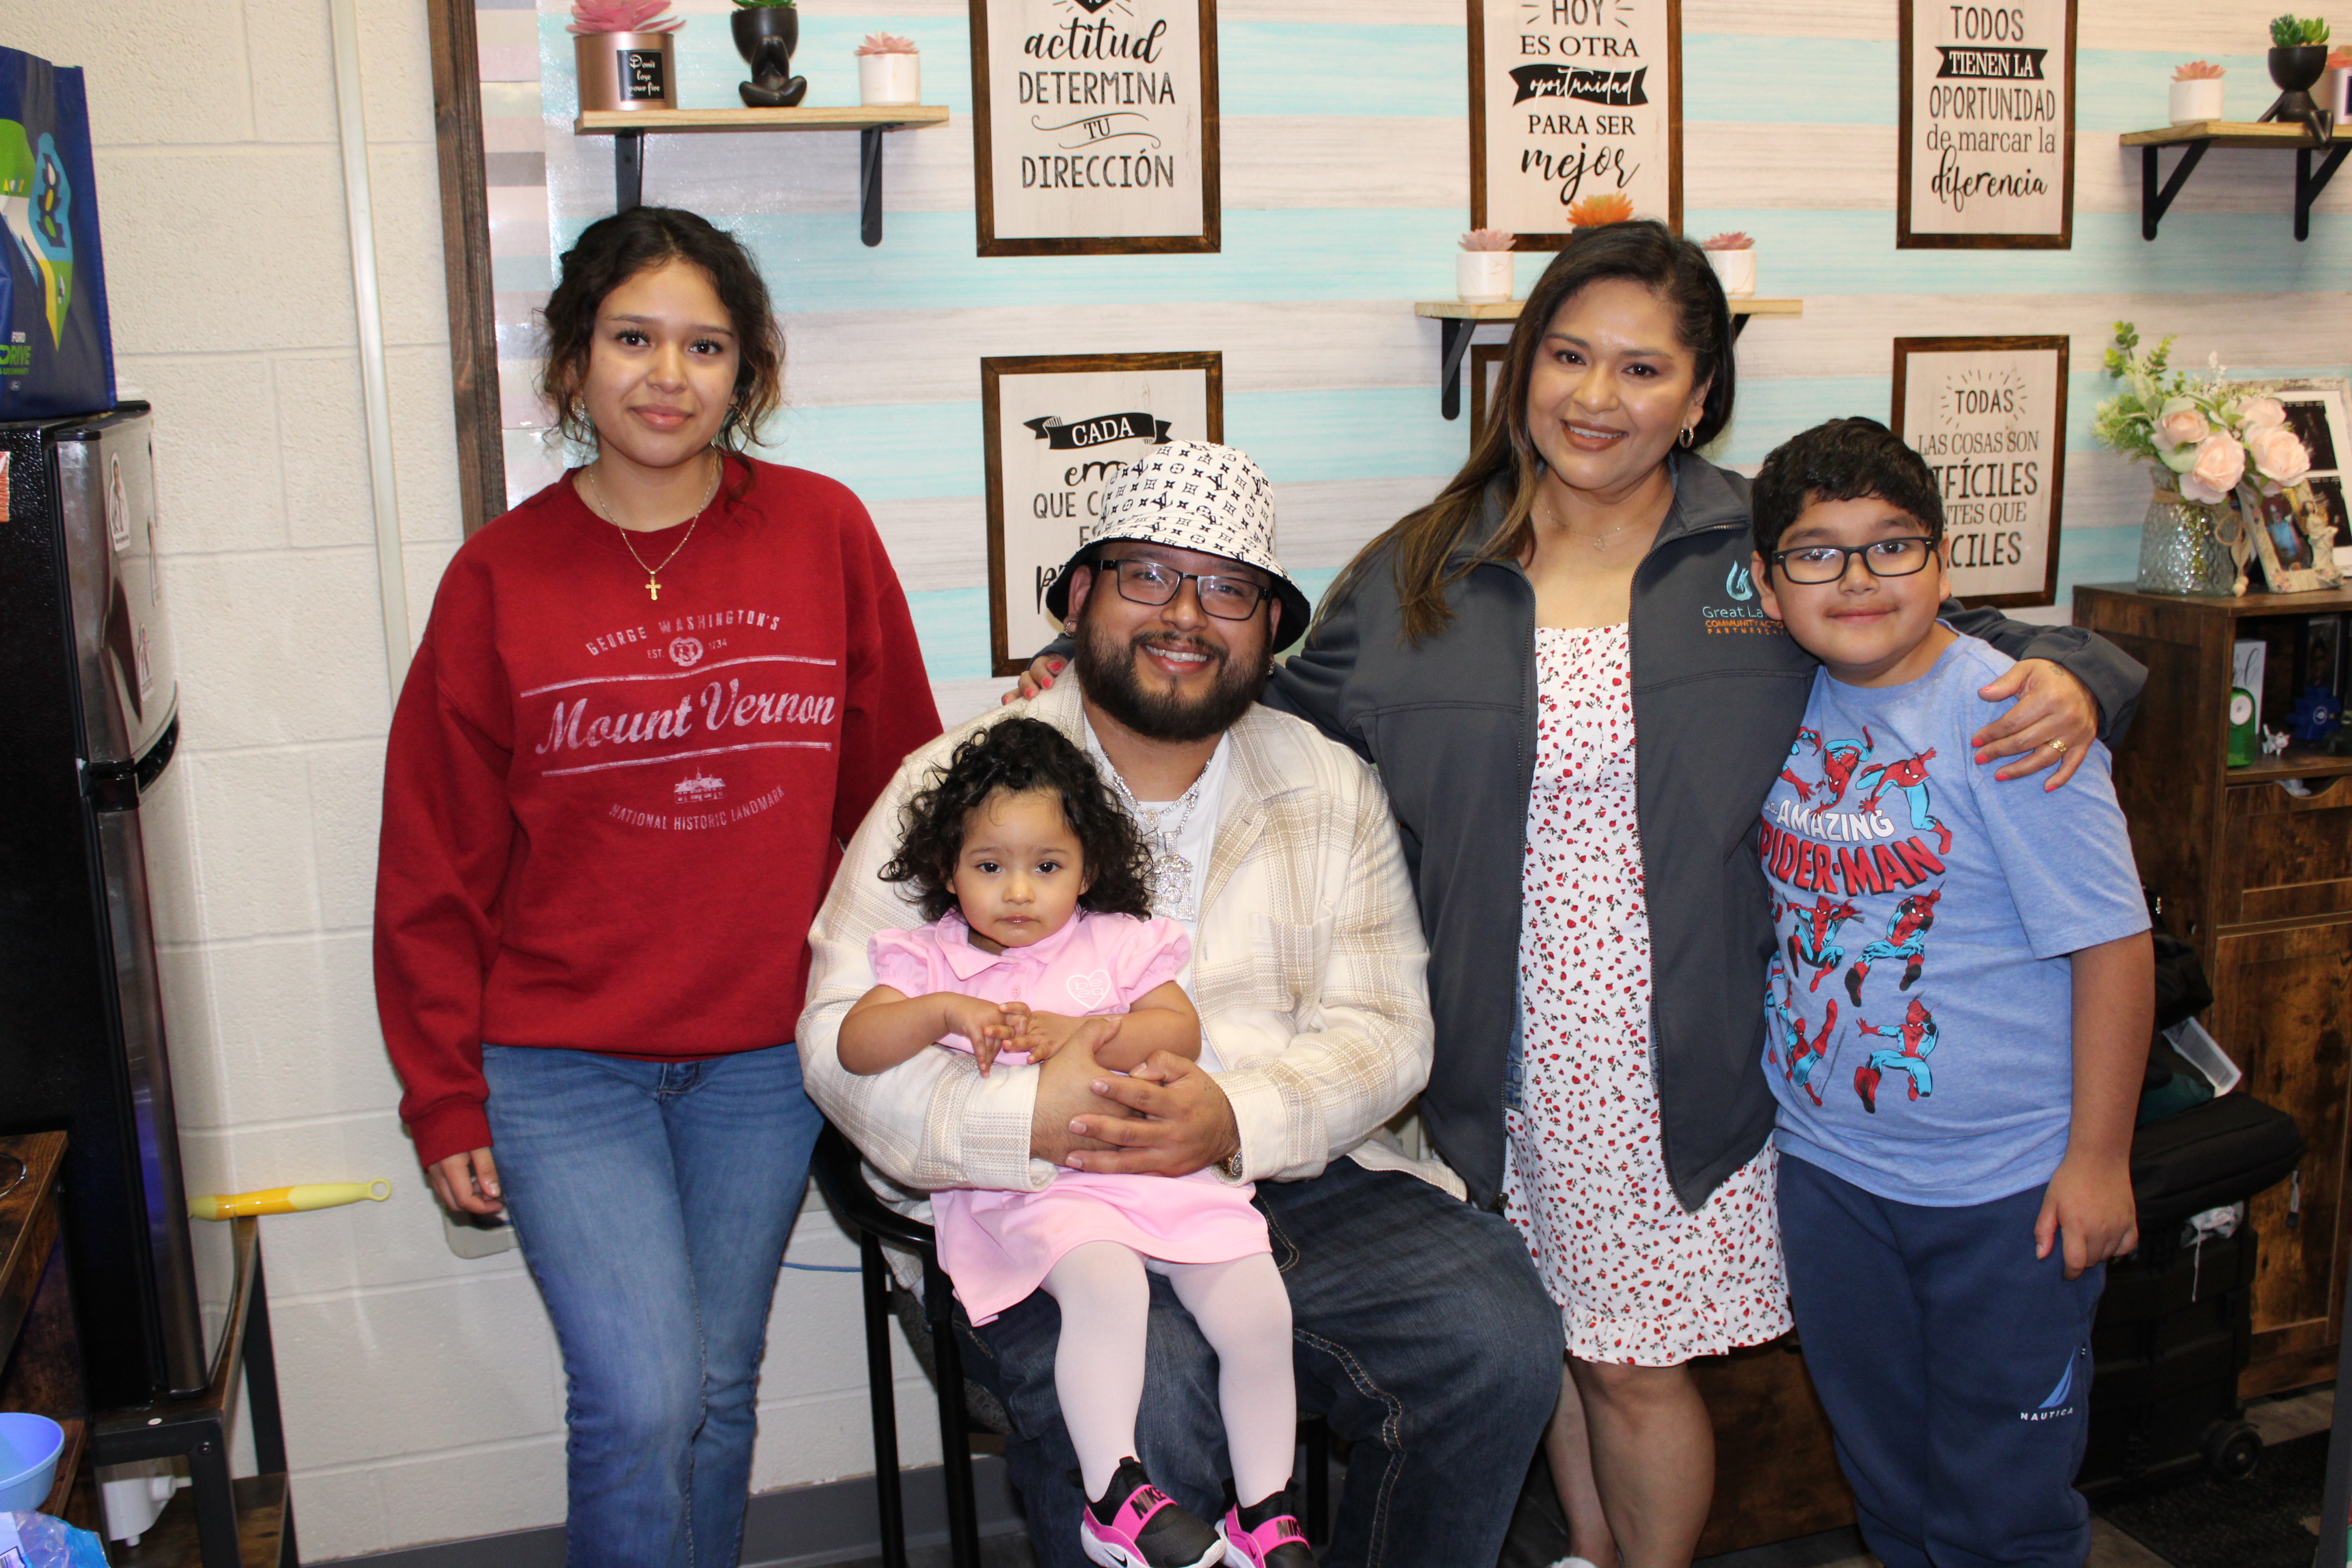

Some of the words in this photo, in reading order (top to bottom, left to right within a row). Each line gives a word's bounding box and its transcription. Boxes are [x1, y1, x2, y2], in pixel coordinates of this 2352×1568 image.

[1552, 0, 1603, 25] HOY
[1950, 6, 2024, 42] TODOS
[1024, 17, 1167, 63] actitud
[1520, 35, 1550, 55] ES
[1559, 36, 1640, 57] OTRA
[1949, 51, 2010, 76] TIENEN
[2014, 54, 2034, 78] LA
[1019, 72, 1176, 104] DETERMINA
[1530, 67, 1636, 113] oportunidad
[1930, 85, 2056, 122] OPORTUNIDAD
[1084, 118, 1111, 140] TU
[1528, 115, 1589, 134] PARA
[1596, 116, 1636, 135] SER
[1927, 124, 1952, 151] de
[1958, 131, 2032, 152] marcar
[2038, 127, 2056, 153] la
[1022, 149, 1173, 188] DIRECCIÓN
[1521, 142, 1640, 205] mejor
[1931, 145, 2048, 212] diferencia
[1955, 389, 2014, 414] TODAS
[1072, 417, 1135, 446] CADA
[1918, 434, 1947, 456] LAS
[1952, 433, 2004, 455] COSAS
[2007, 431, 2040, 453] SON
[1933, 458, 2038, 499] IFÍCILES
[1033, 492, 1076, 519] QUE
[1990, 501, 2027, 526] QUE
[1950, 532, 2022, 568] CILES
[1702, 606, 1744, 618] Great
[586, 626, 647, 656] GEORGE
[659, 610, 780, 634] WASHINGTON'S
[647, 649, 665, 659] EST.
[535, 695, 692, 754] Mount
[700, 678, 835, 731] Vernon
[609, 804, 667, 829] NATIONAL
[674, 812, 727, 830] HISTORIC
[731, 785, 784, 822] LANDMARK
[1776, 799, 1896, 842] AMAZING
[1759, 814, 1945, 897] PIDER-MAN
[2020, 1407, 2074, 1421] NAUTICA
[1130, 1487, 1167, 1520] NIKE
[1276, 1519, 1305, 1540] NIK
